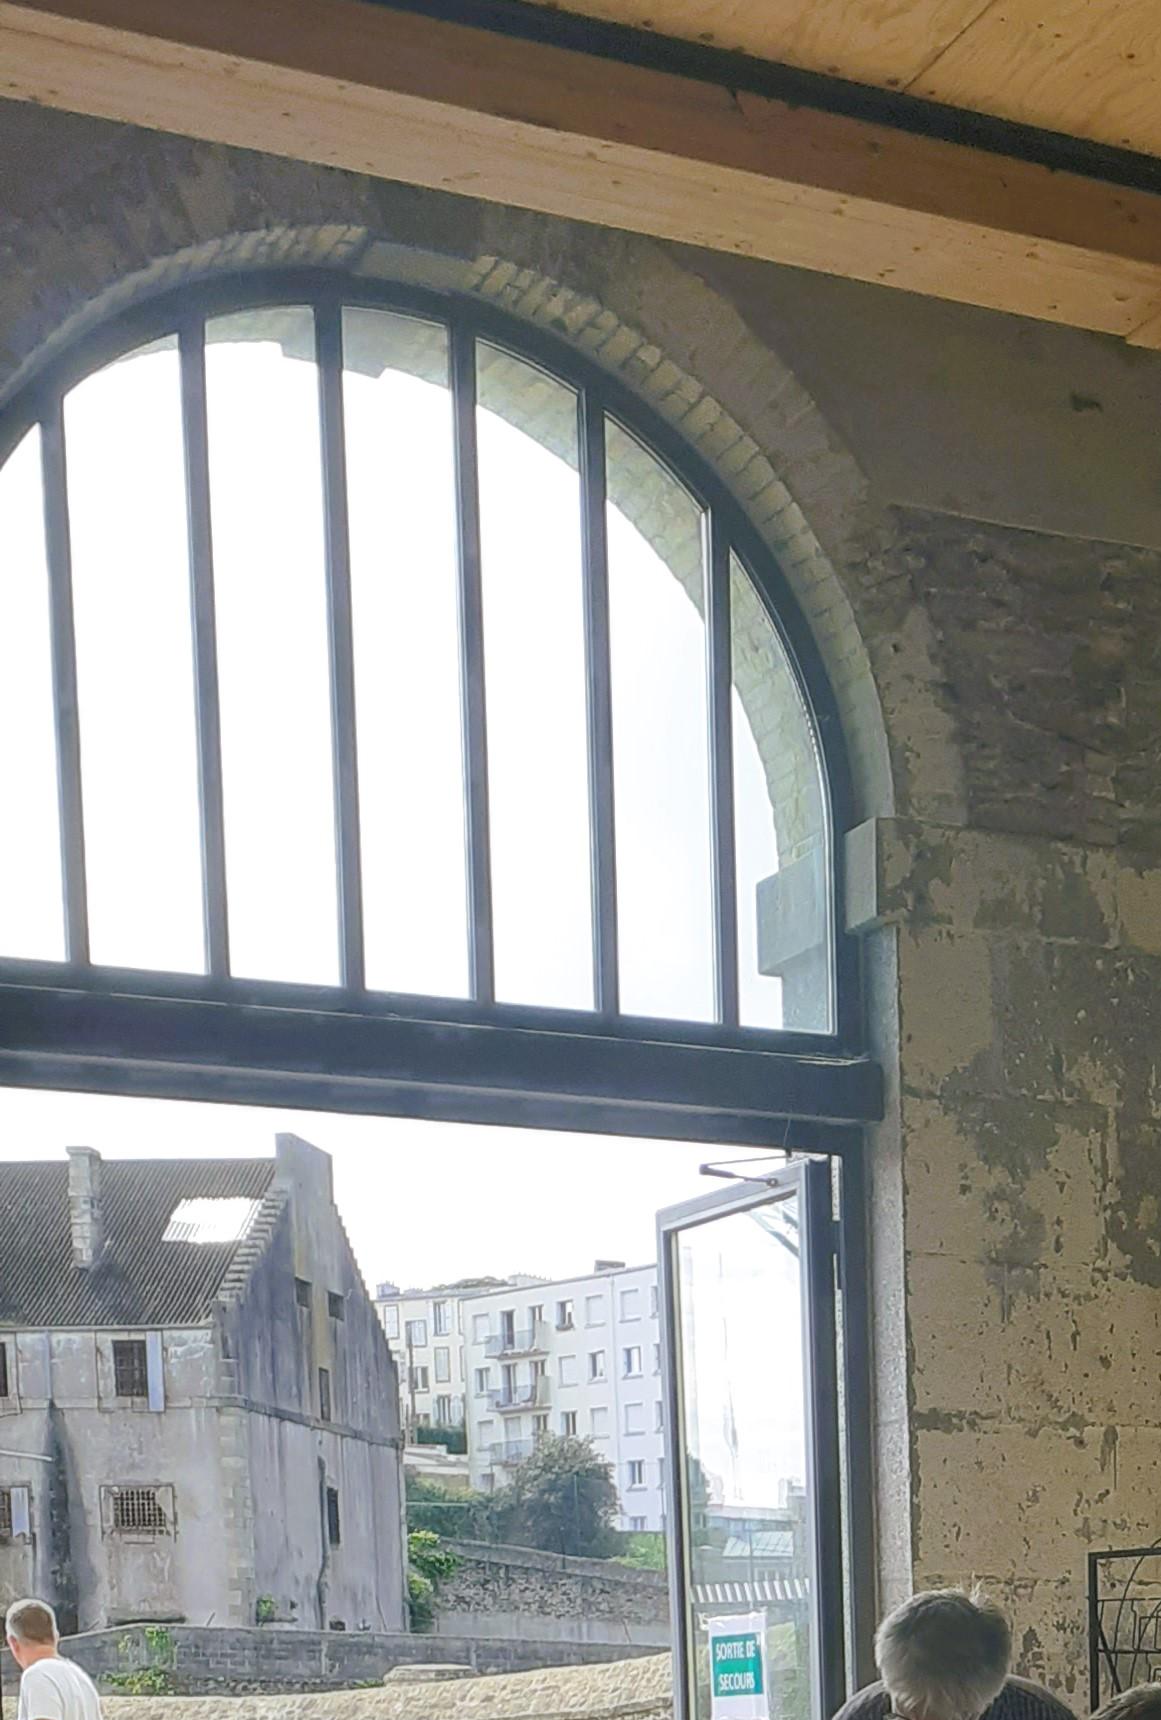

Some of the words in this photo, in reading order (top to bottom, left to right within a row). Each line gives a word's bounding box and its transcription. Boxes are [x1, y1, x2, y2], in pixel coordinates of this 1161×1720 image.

[716, 1641, 744, 1662] SORTIE
[746, 1640, 755, 1658] DE
[719, 1672, 755, 1691] SECOURS
